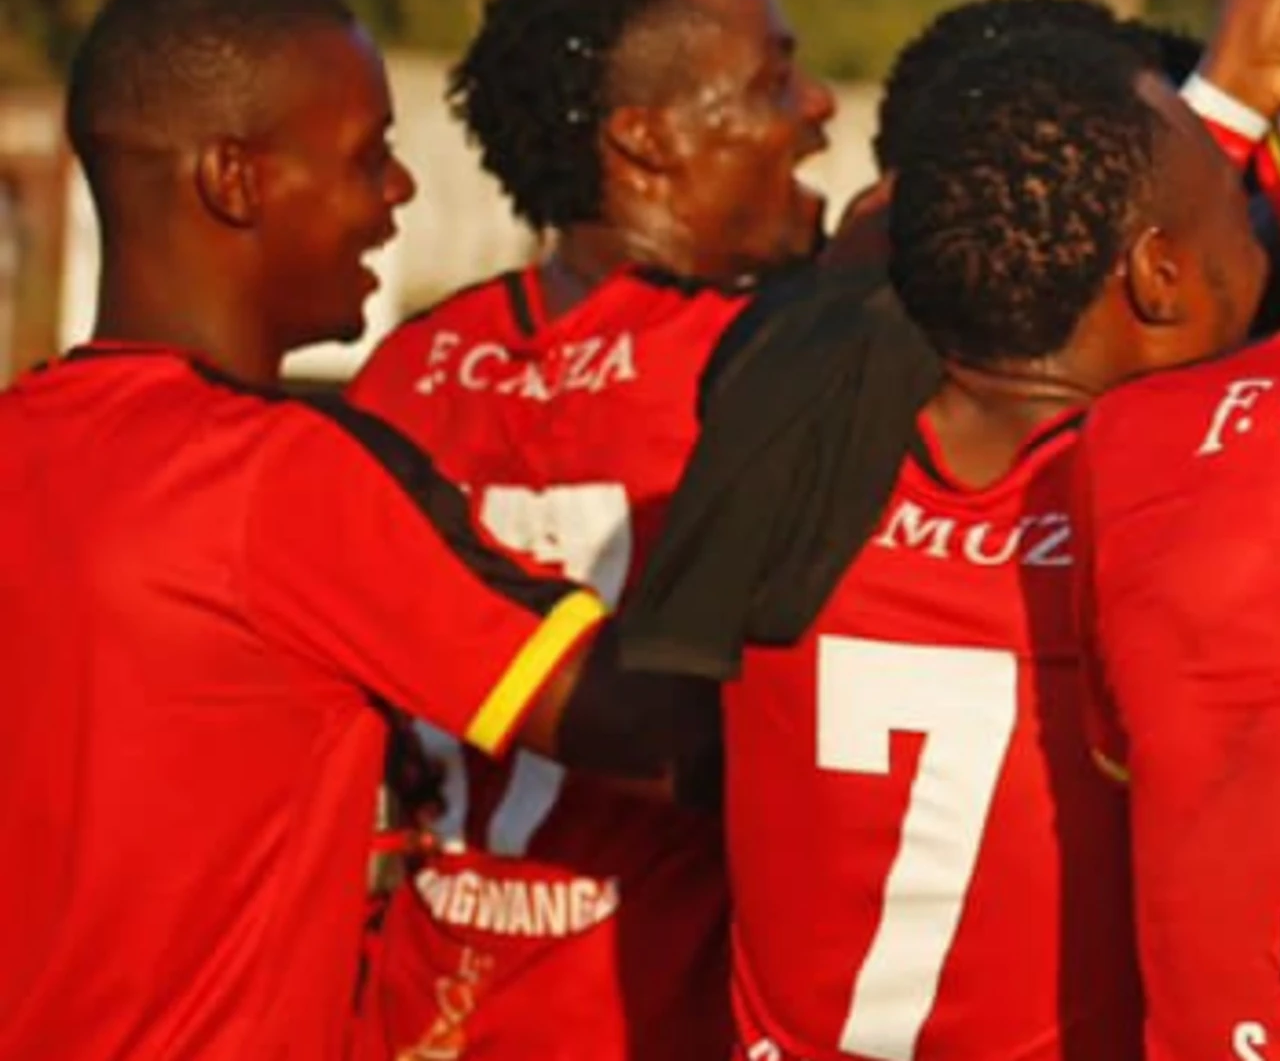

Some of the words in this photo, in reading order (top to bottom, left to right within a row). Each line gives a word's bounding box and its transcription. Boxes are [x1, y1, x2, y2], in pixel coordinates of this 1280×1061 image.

[458, 342, 510, 390] C
[1196, 378, 1274, 455] F.
[874, 499, 1075, 566] MUZ
[816, 634, 1017, 1061] 7
